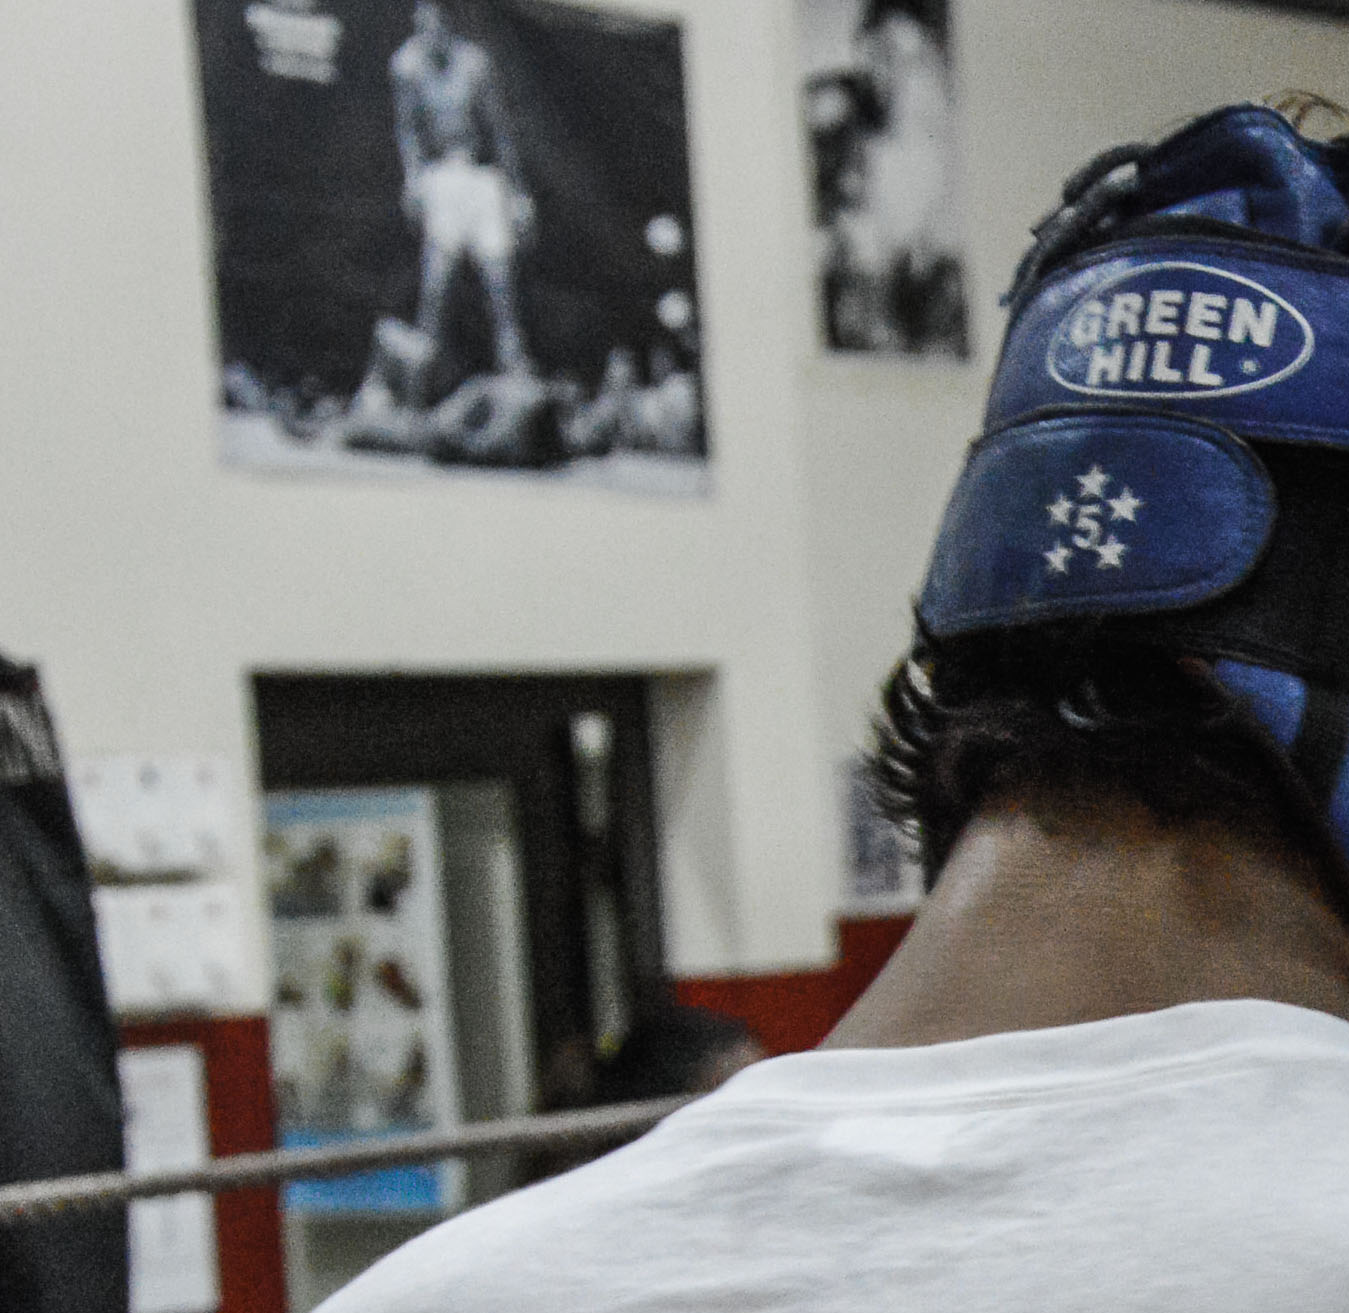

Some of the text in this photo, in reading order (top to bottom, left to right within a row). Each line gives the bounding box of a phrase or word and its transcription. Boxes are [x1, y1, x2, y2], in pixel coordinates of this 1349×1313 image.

[1071, 289, 1279, 348] GREEN
[1086, 340, 1224, 387] HILL
[1072, 504, 1103, 552] 5
